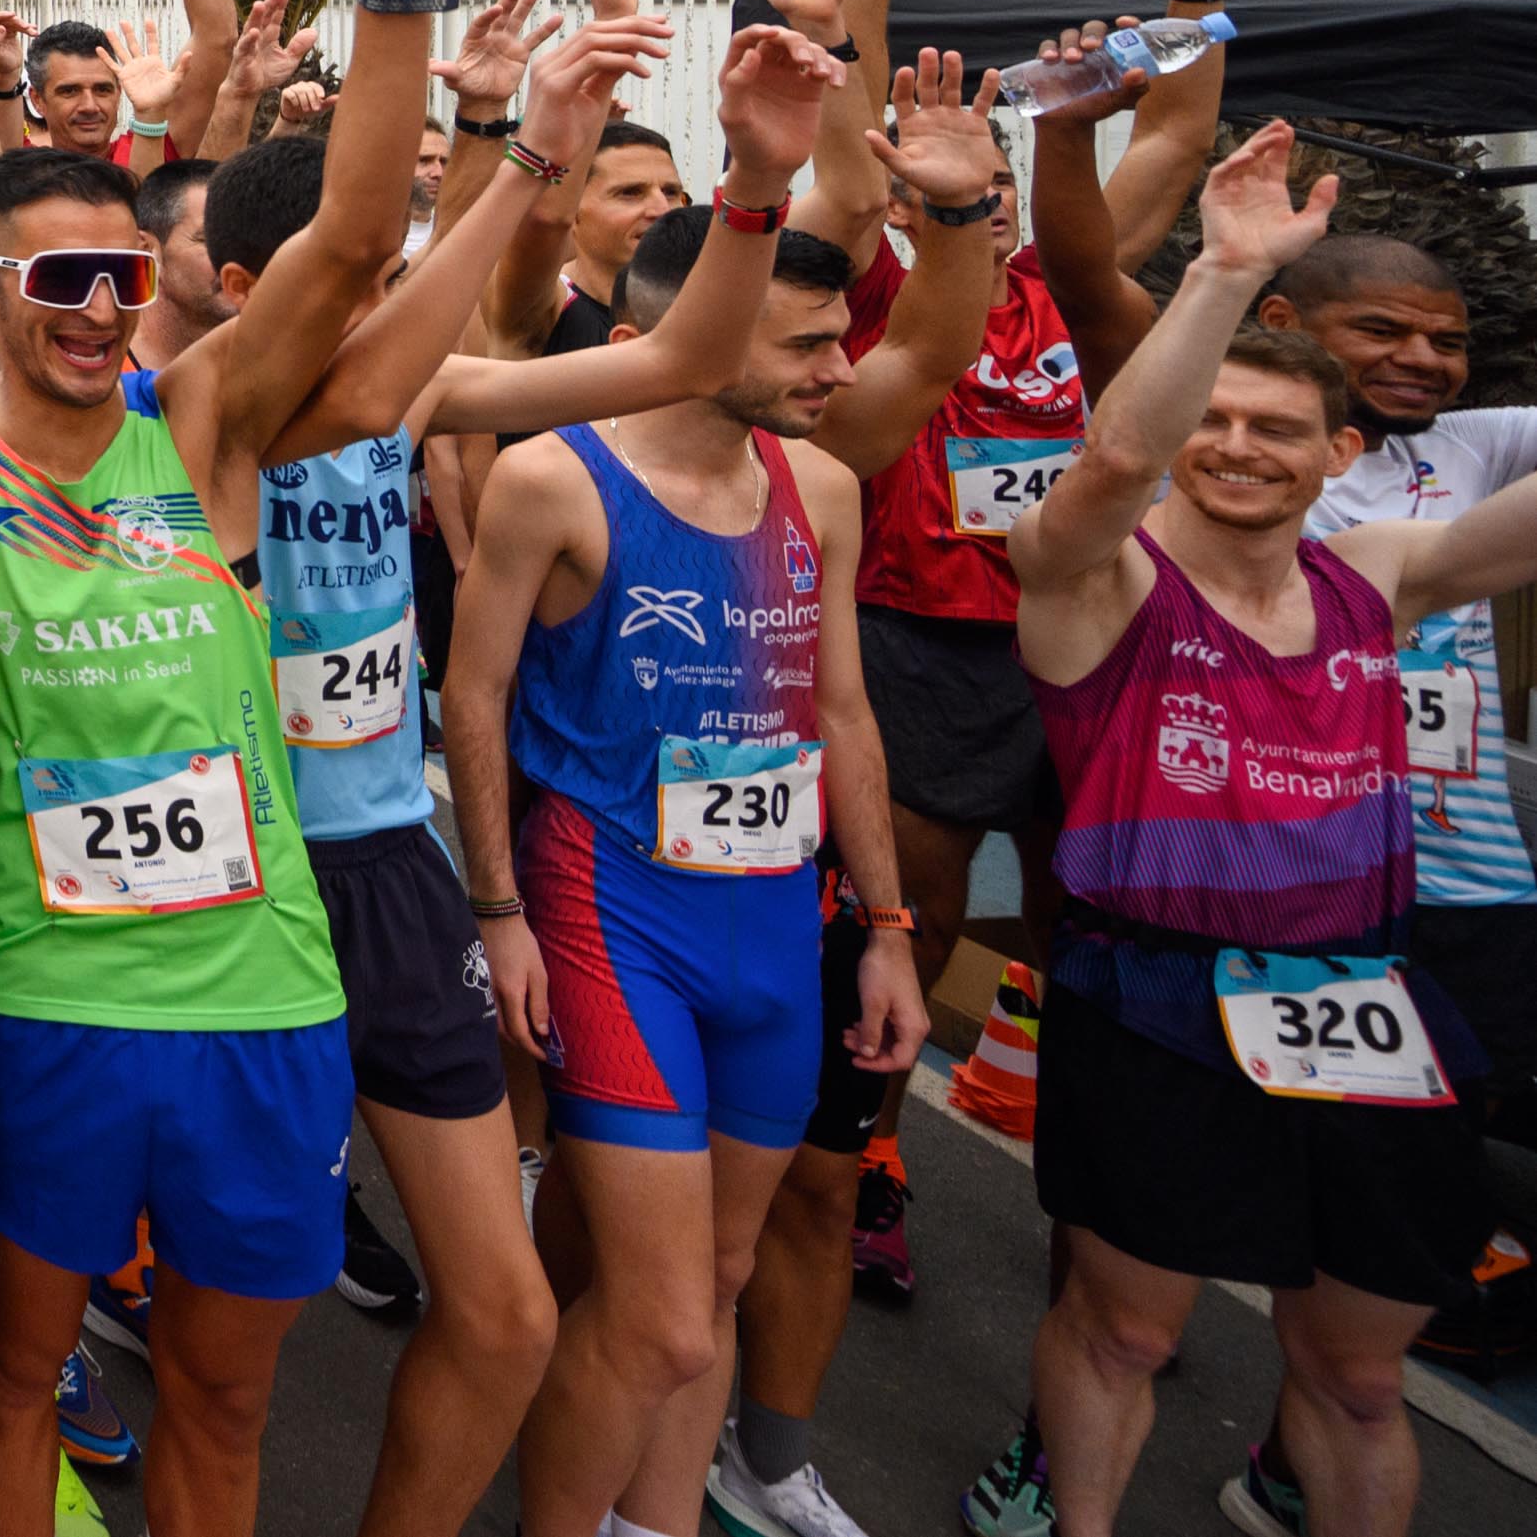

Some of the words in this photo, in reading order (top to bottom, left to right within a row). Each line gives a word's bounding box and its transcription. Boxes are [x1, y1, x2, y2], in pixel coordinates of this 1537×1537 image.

[34, 603, 217, 654] SAKATA
[124, 666, 141, 681] in
[144, 655, 193, 679] Seed
[322, 643, 402, 701] 244
[699, 710, 784, 731] ATLETISMO
[238, 689, 277, 826] Atletismo
[1241, 737, 1361, 766] Ayuntamien
[81, 798, 204, 860] 256
[703, 782, 791, 828] 230
[134, 858, 166, 869] ANTONIO
[1272, 996, 1403, 1053] 320
